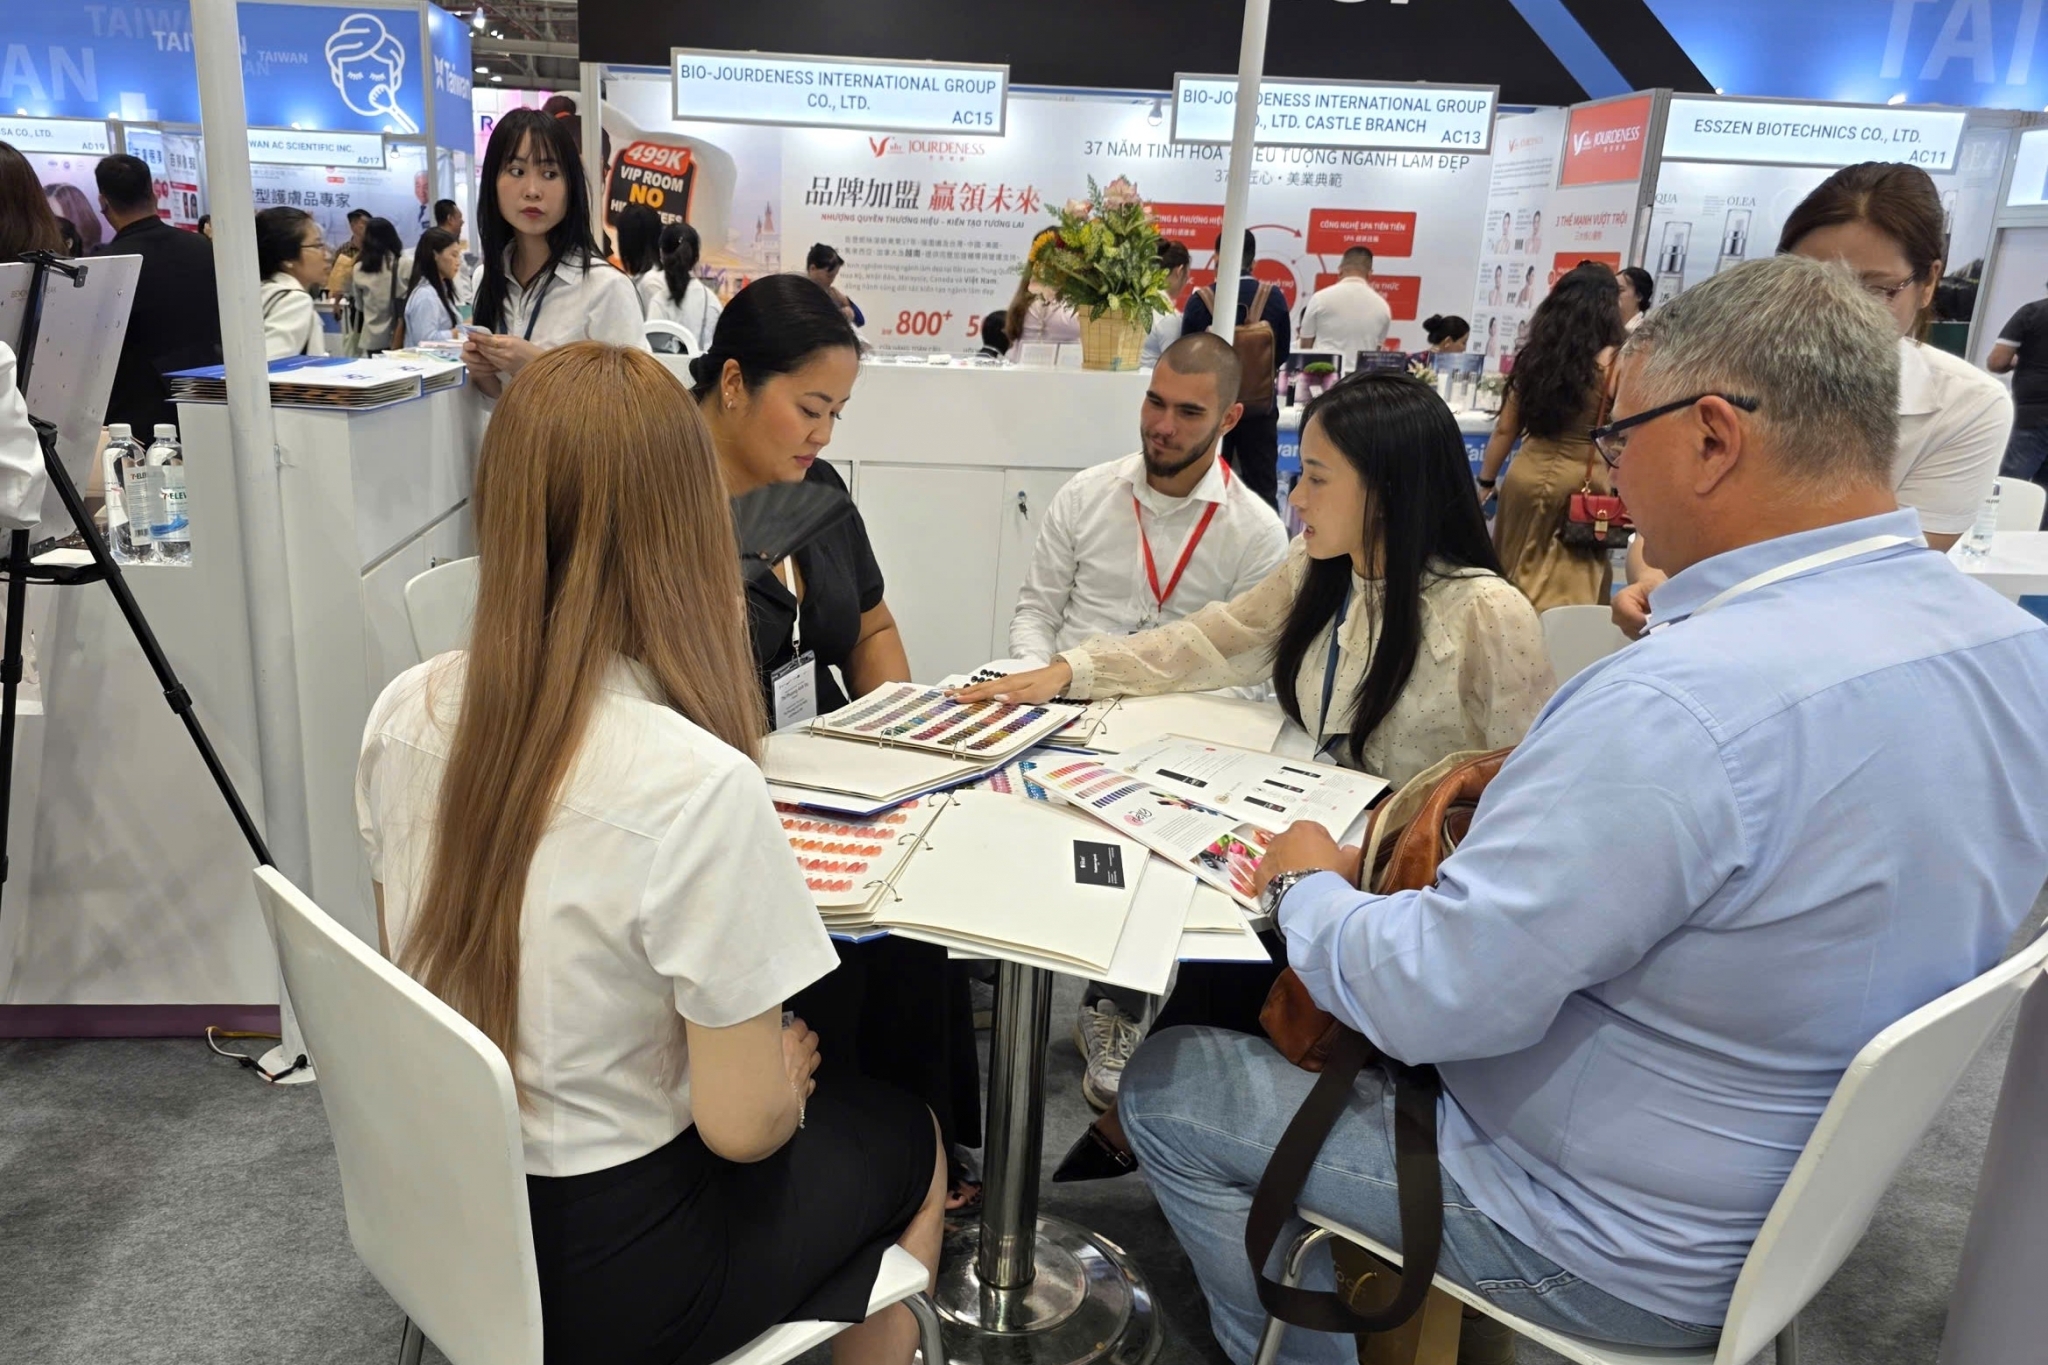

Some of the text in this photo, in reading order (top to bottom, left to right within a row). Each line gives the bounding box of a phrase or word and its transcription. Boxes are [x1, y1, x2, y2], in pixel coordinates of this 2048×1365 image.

[258, 51, 308, 64] TAIWAN
[681, 64, 997, 94] BIO-JOURDENESS INTERNATIONAL GROUP
[807, 93, 870, 111] CO., LTD.
[1183, 89, 1487, 114] BIO-JODENESS INTERNATIONAL GROUP
[952, 110, 993, 126] AC15
[1271, 114, 1301, 129] LTD.
[1305, 115, 1362, 131] CASTLE
[1365, 117, 1427, 133] BRANCH
[35, 129, 54, 138] LTD.
[1441, 130, 1481, 144] AC13
[1593, 126, 1640, 147] JOURDENESS
[1693, 118, 1922, 144] ESSZEN BIOTECHNICS CO., LTD.
[82, 142, 105, 151] AD19
[249, 140, 355, 153] WAN AC SCIENTIFIC INC.
[909, 139, 986, 155] JOURDENESS
[357, 156, 380, 165] AD17
[628, 144, 686, 171] 499K
[1084, 141, 1103, 156] 37
[1107, 139, 1142, 157] NĂM
[1147, 143, 1185, 159] TINH
[1189, 145, 1223, 160] HOA
[1438, 154, 1470, 173] ĐẸP
[1909, 149, 1947, 164] AC11
[620, 165, 684, 193] VIP ROOM
[252, 188, 351, 208] 型護膚品專家
[629, 183, 664, 208] NO
[805, 176, 921, 210] 品牌加盟
[1655, 193, 1678, 204] QUA
[1726, 196, 1756, 206] OLEA
[1360, 222, 1373, 230] SPA
